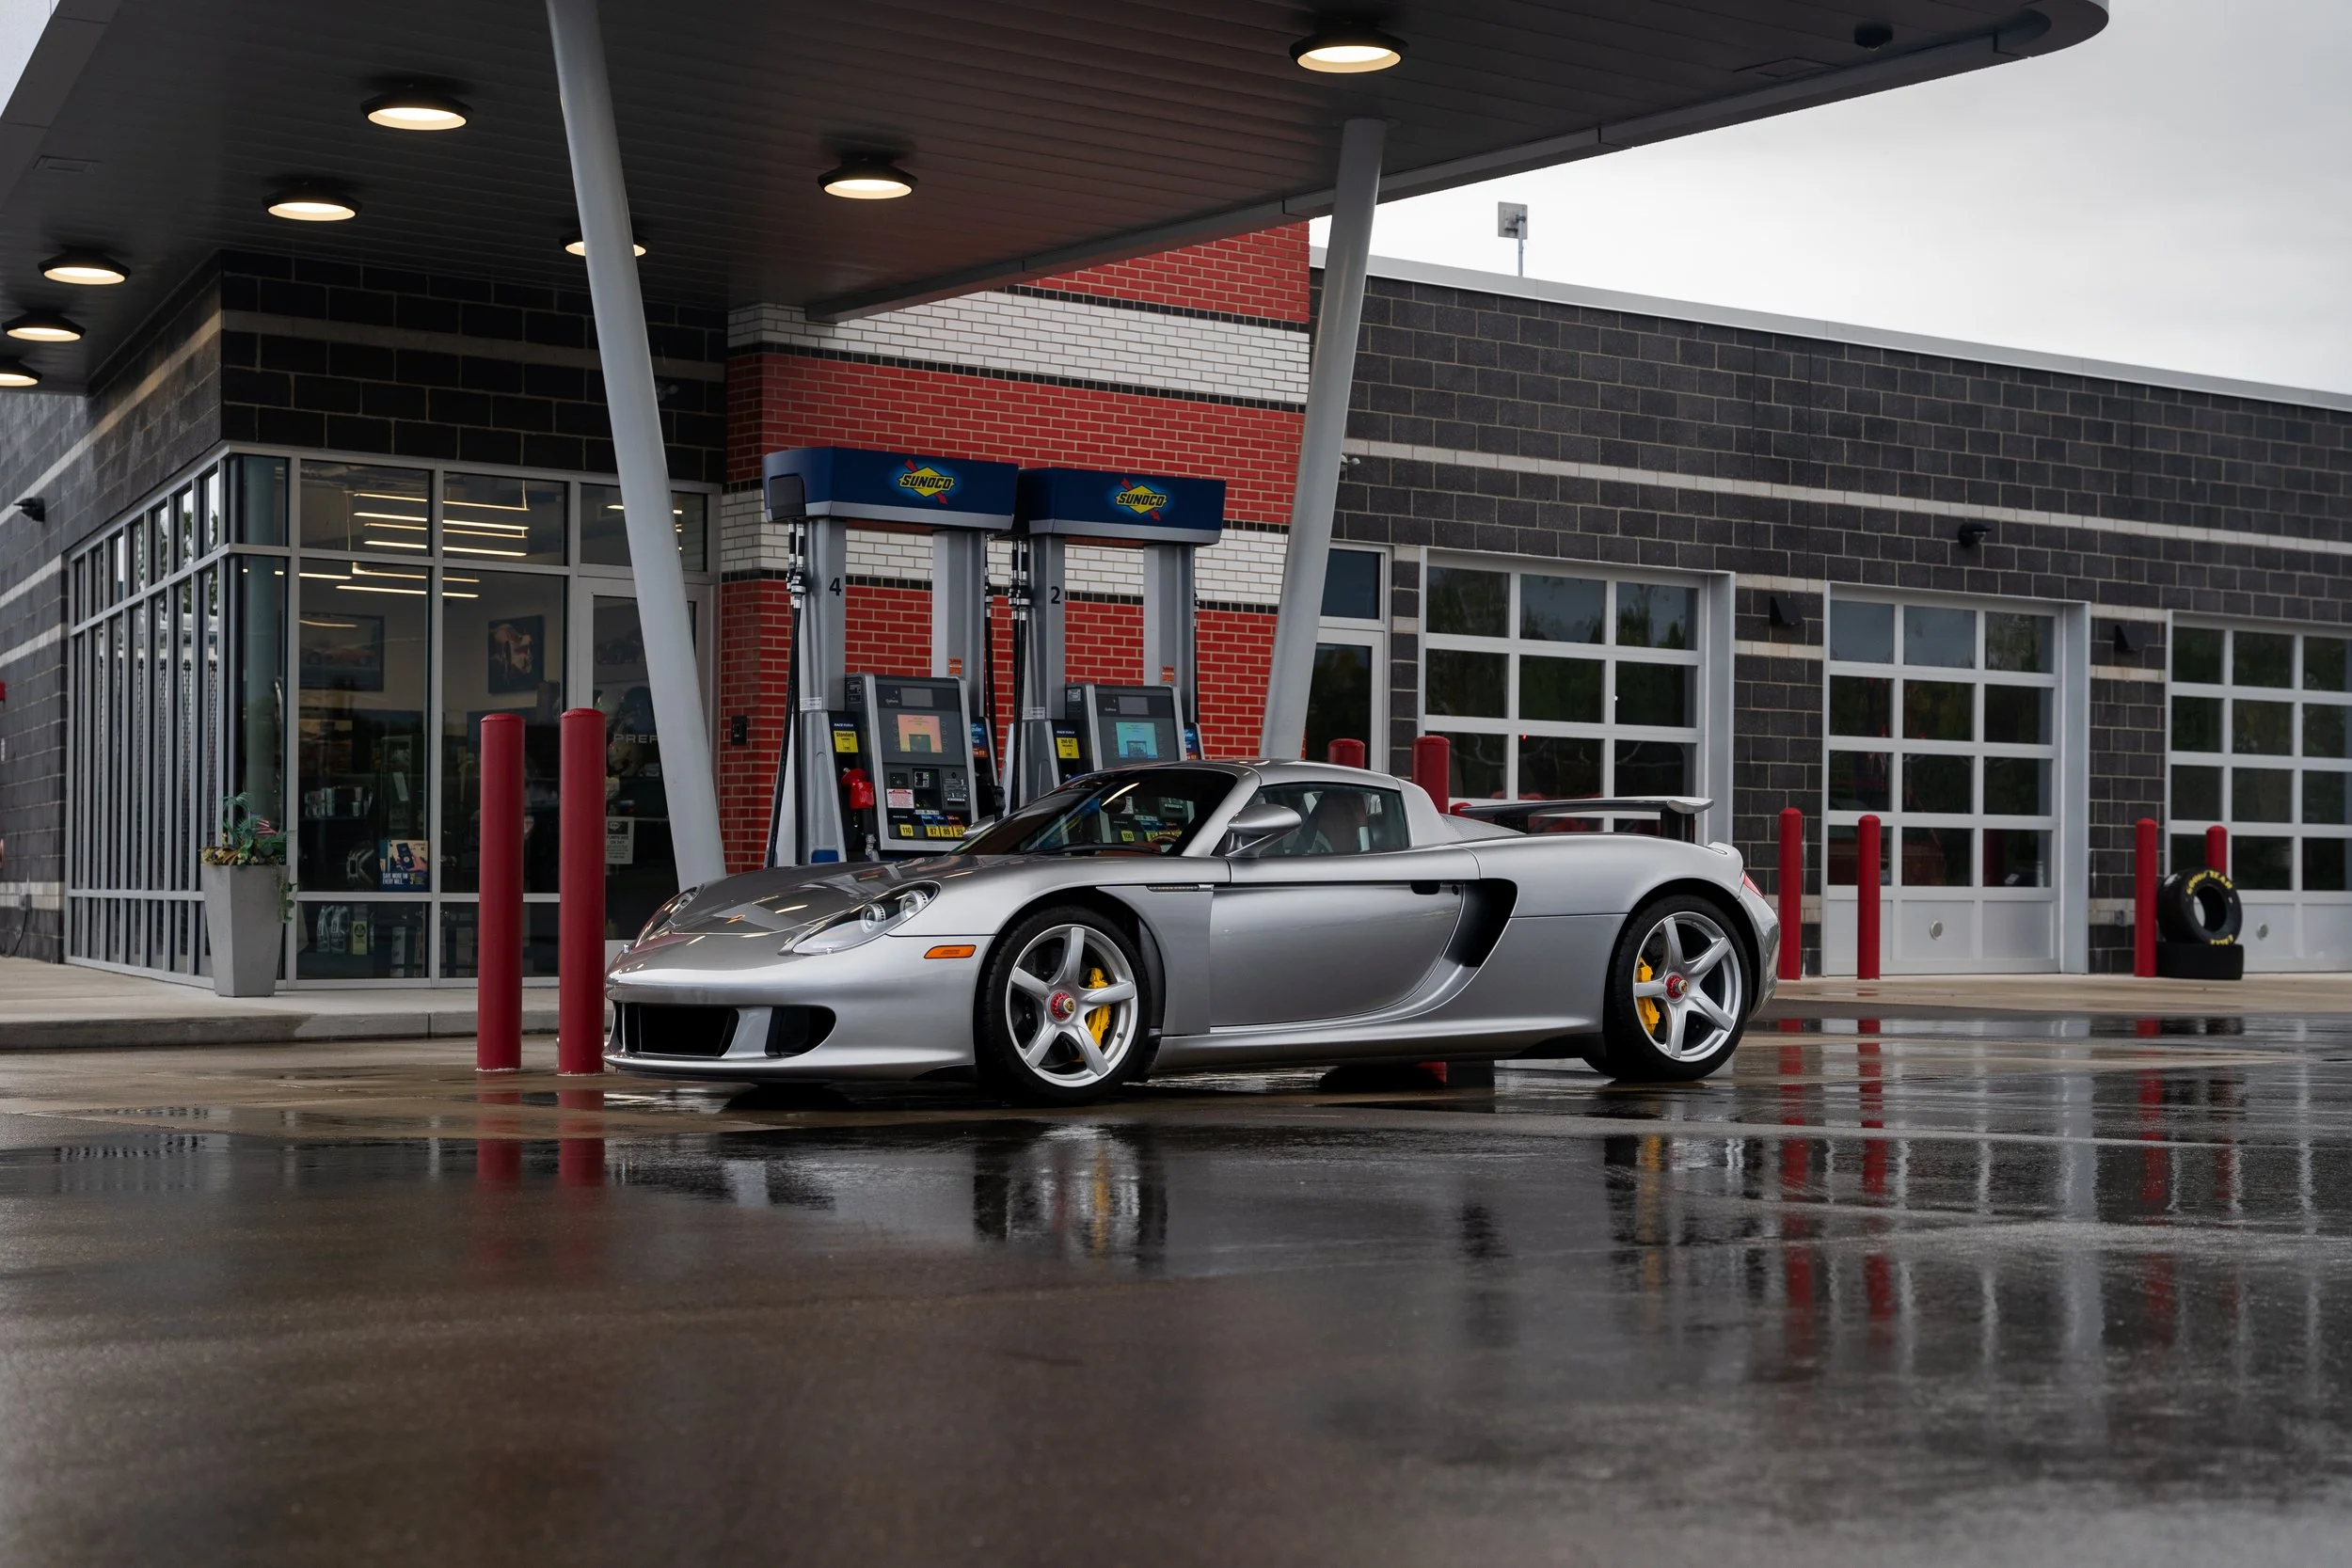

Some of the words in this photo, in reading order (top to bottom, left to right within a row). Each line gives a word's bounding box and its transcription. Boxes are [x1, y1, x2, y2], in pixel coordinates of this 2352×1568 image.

[902, 474, 952, 489] SUNOCO
[1118, 493, 1165, 507] SUNOCO
[829, 578, 842, 596] 4
[1051, 586, 1060, 604] 2
[902, 827, 912, 835] 110
